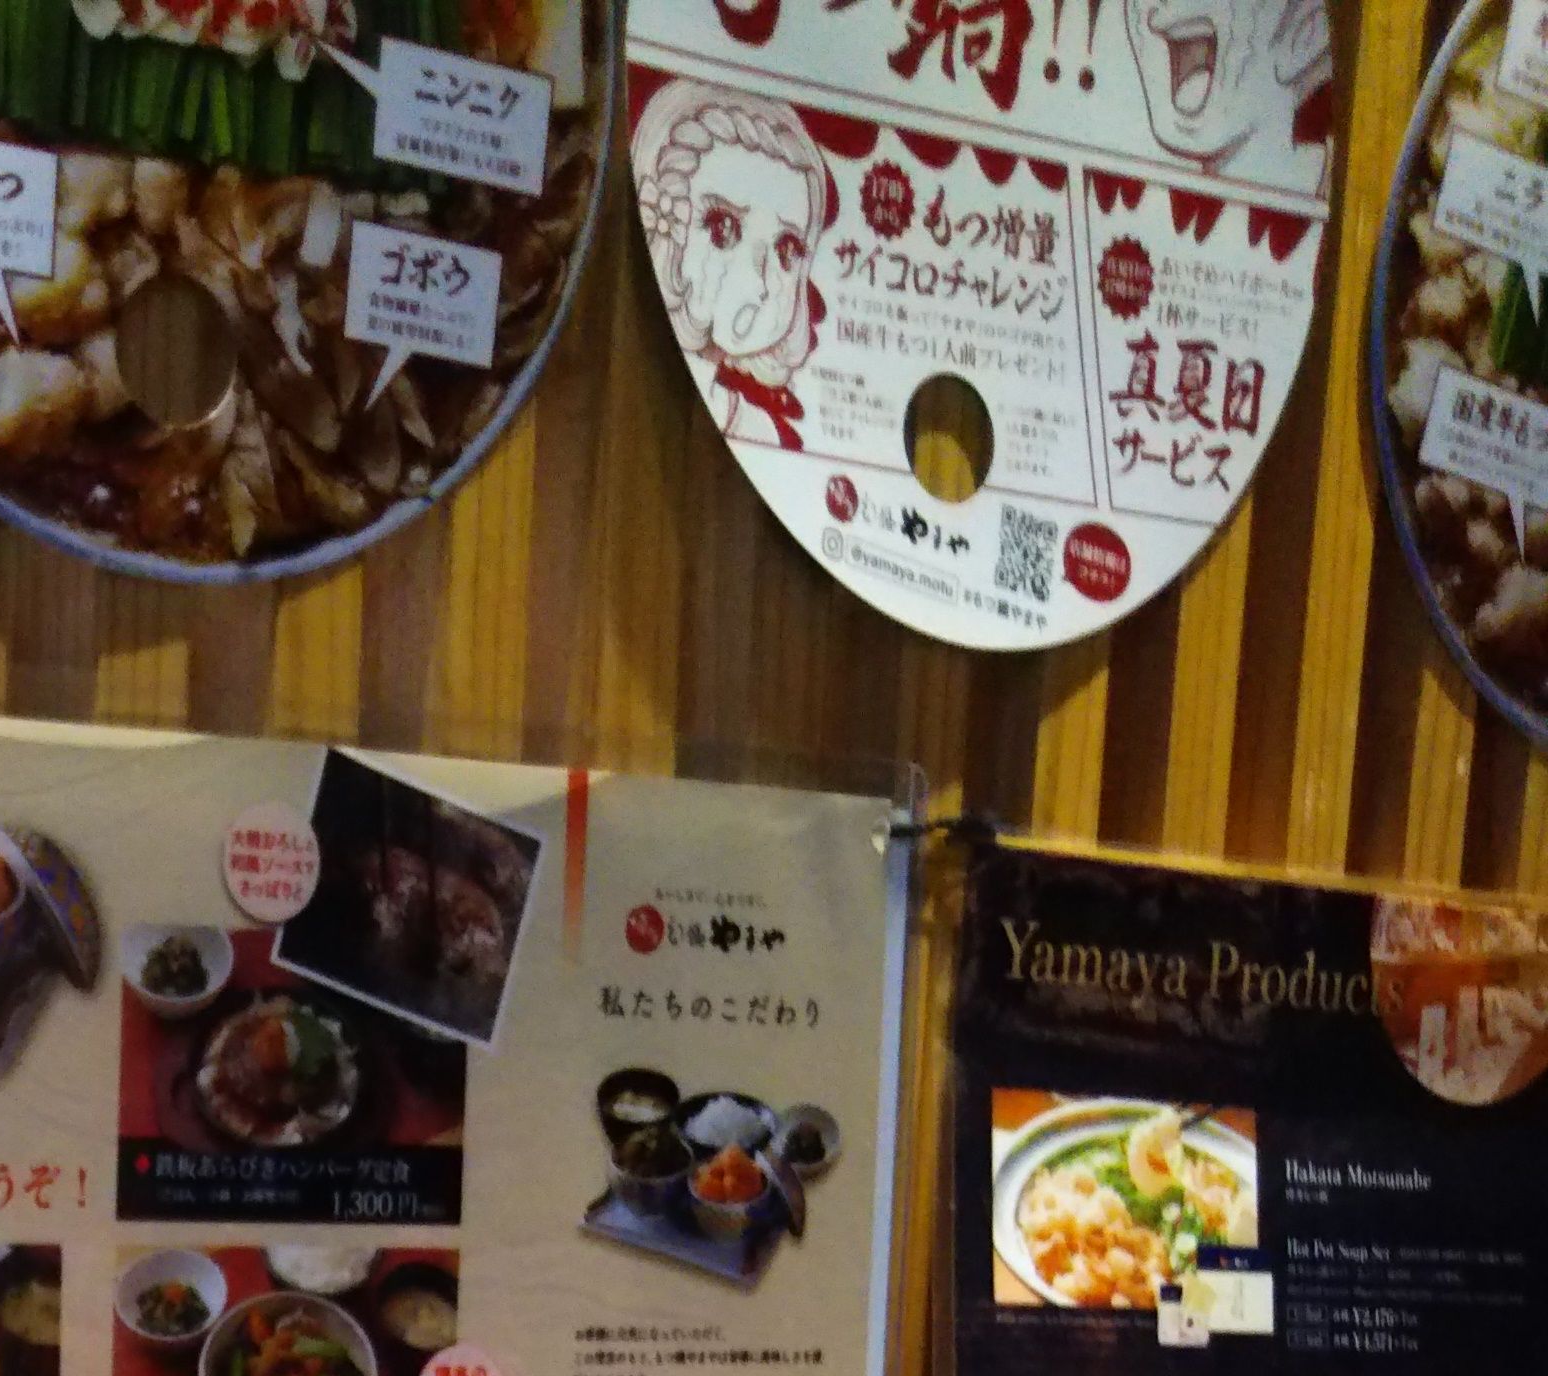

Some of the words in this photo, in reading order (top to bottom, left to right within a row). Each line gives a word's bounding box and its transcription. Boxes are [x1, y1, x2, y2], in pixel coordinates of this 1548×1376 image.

[413, 62, 522, 121] ニンニク
[379, 242, 473, 298] ゴボウ
[833, 236, 1069, 322] サイコロチャレンジ
[1108, 327, 1267, 440] 真夏日
[1112, 428, 1232, 492] サービス
[1000, 915, 1188, 1022] Yamaya
[598, 985, 820, 1029] 私たちのこだわり
